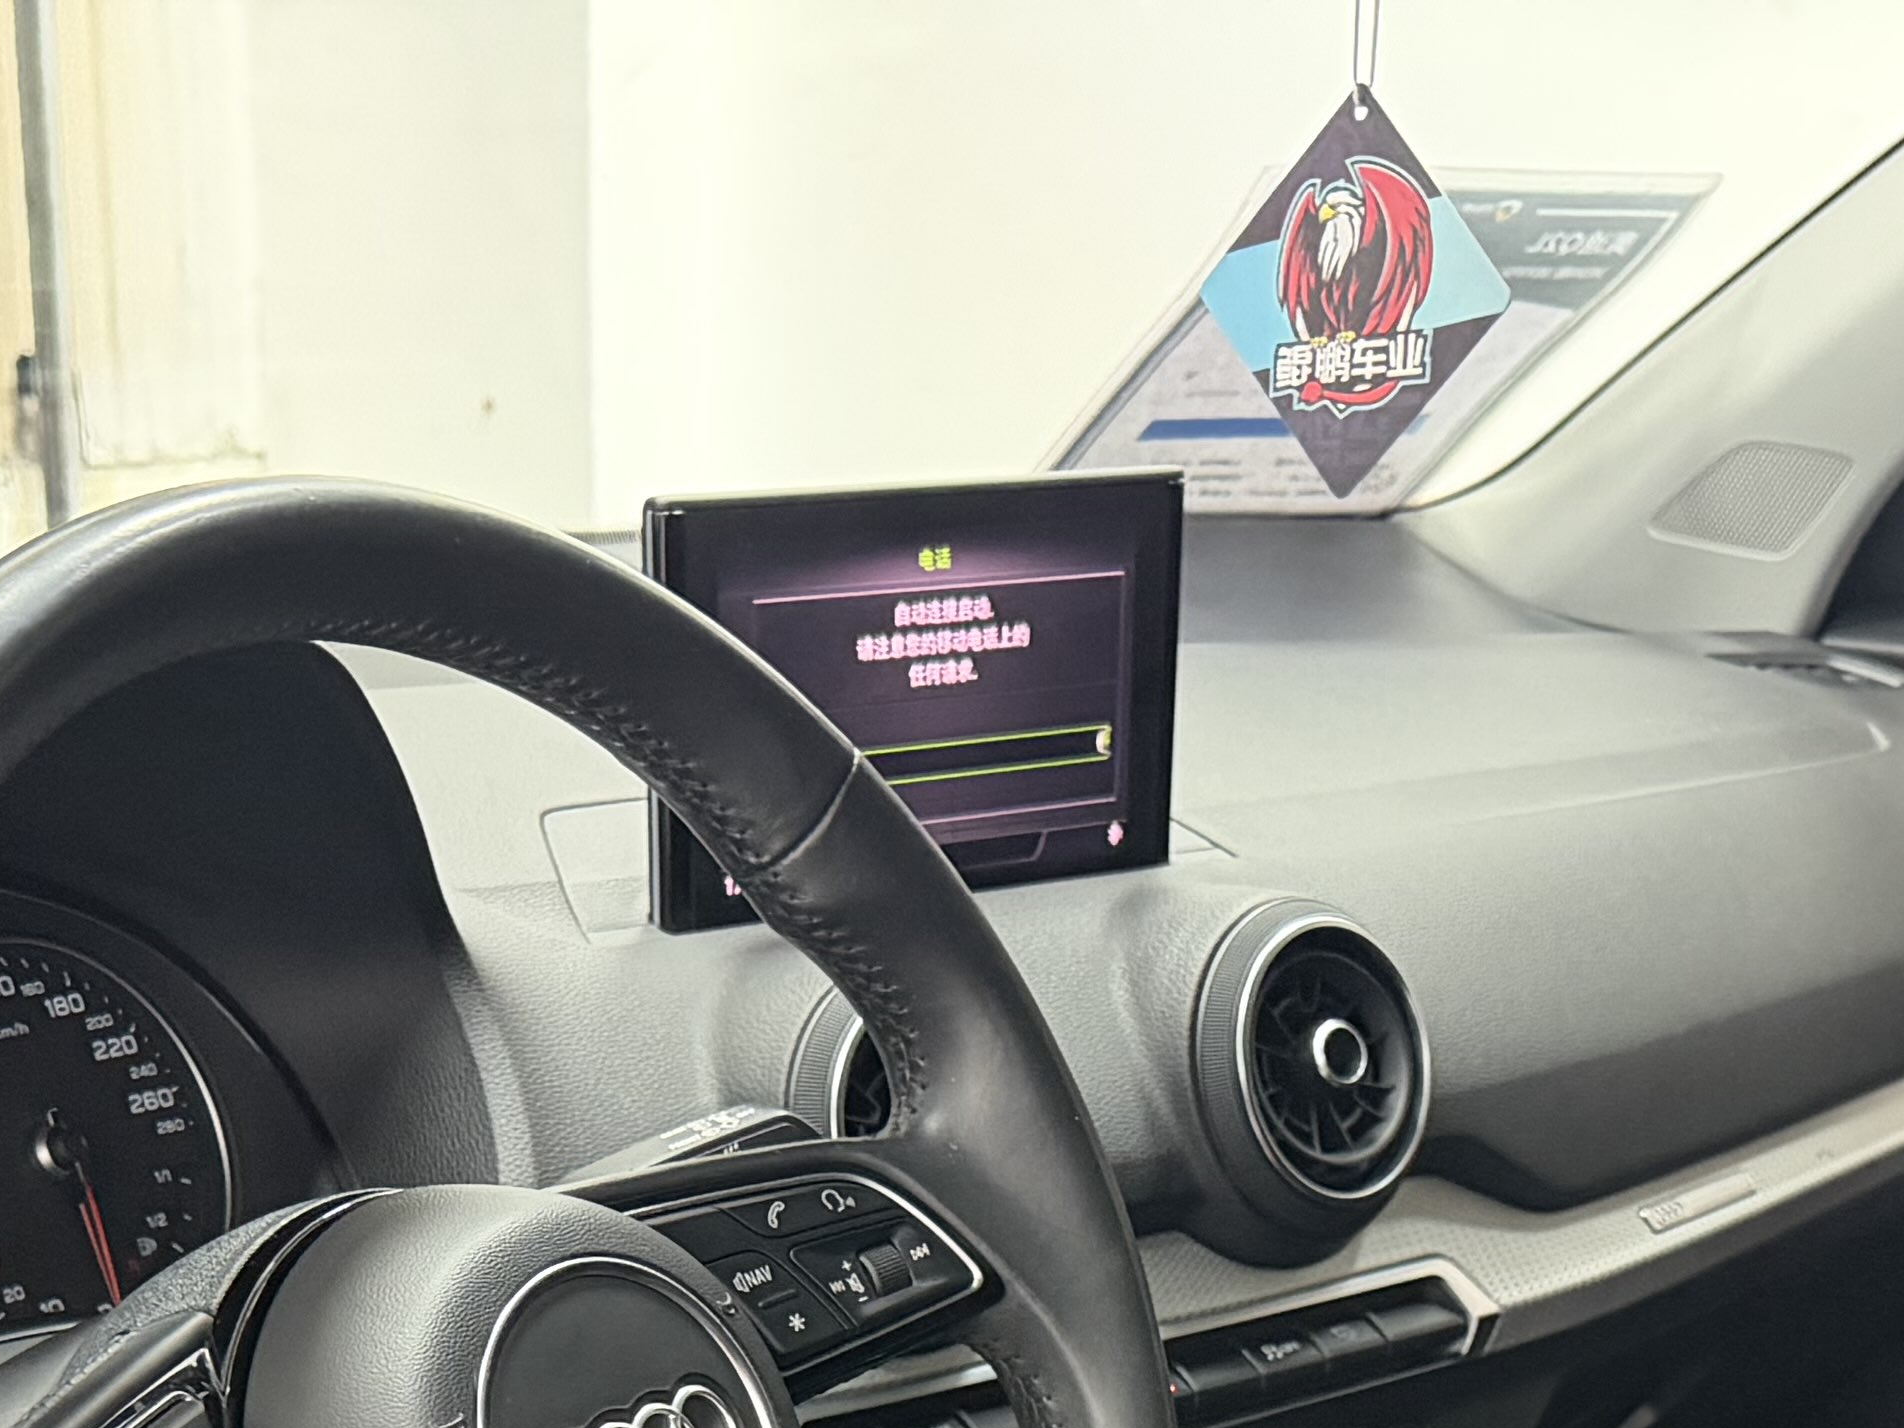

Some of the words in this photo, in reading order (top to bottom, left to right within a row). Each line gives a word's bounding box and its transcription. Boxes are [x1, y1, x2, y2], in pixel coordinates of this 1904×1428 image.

[1274, 336, 1427, 389] 鲲鹏车业
[918, 545, 952, 571] 电话
[44, 992, 86, 1018] 180
[85, 1013, 114, 1031] 200
[91, 1034, 139, 1061] 220
[129, 1062, 158, 1080] 240
[127, 1087, 175, 1115] 260
[743, 1264, 773, 1288] NAV
[2, 1285, 26, 1304] 20
